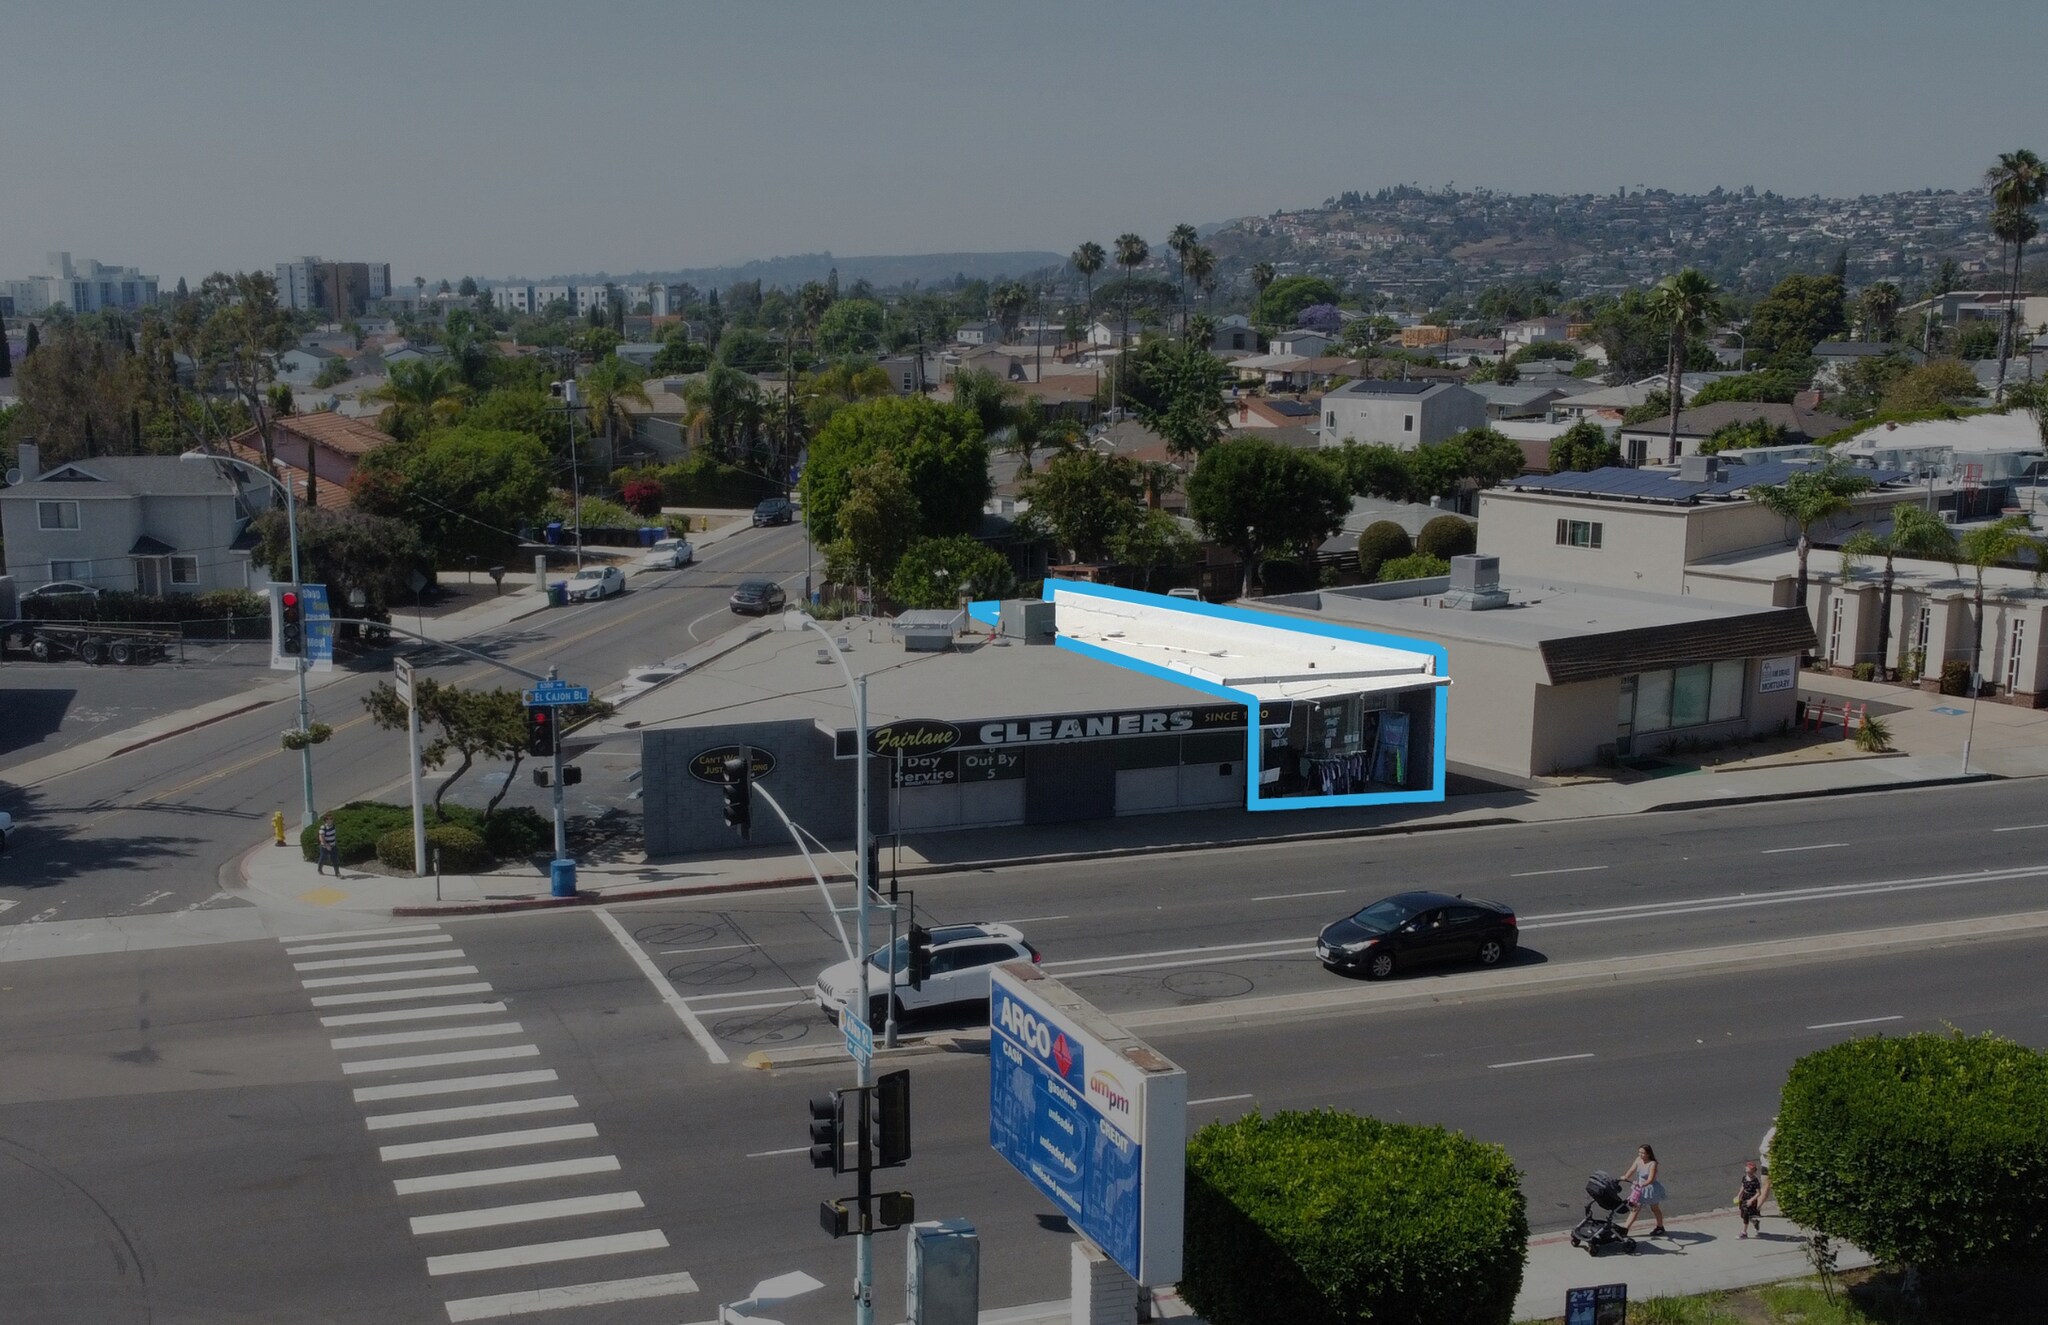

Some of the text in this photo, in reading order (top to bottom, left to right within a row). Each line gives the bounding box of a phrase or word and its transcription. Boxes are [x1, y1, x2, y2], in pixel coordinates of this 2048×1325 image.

[980, 710, 1193, 744] CLEANERS
[1205, 709, 1269, 722] SINCE 10
[875, 727, 953, 752] Fairlane
[907, 757, 941, 768] Day
[966, 754, 1017, 767] Out By
[987, 769, 996, 779] 5
[895, 769, 954, 783] Service
[1001, 996, 1051, 1058] ARCO
[1003, 1041, 1022, 1067] CASH
[1048, 1079, 1077, 1110] gasoline
[1090, 1076, 1129, 1114] ampm
[1048, 1108, 1073, 1136] unleaded
[1100, 1118, 1128, 1153] CREDIT
[1040, 1135, 1077, 1174] unleaded plus
[1032, 1163, 1081, 1214] unleaded premium
